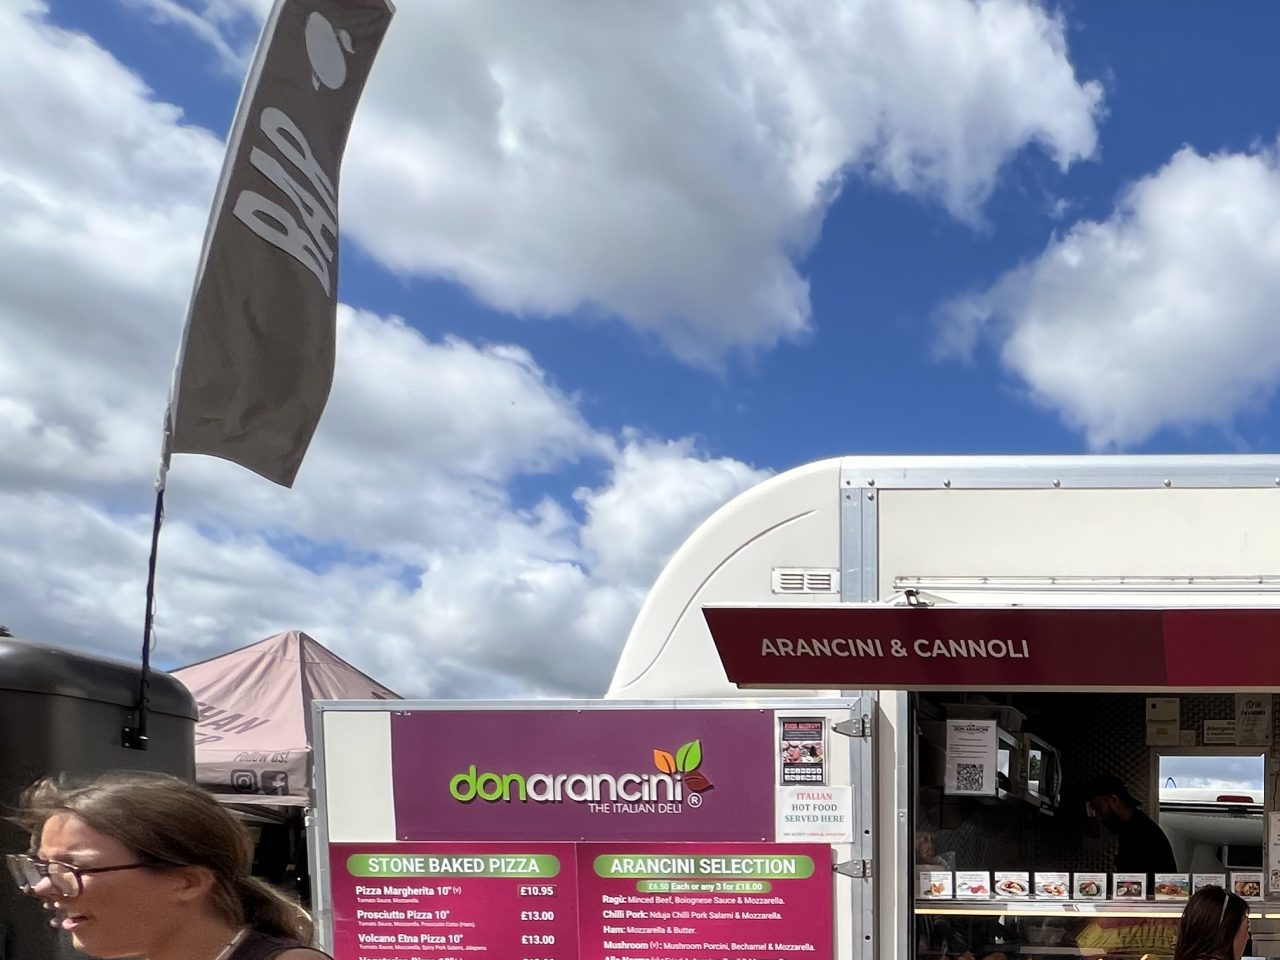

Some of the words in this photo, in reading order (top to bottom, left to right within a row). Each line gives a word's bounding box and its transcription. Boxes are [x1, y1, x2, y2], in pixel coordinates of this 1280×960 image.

[761, 638, 884, 657] ARANCINI
[890, 639, 908, 657] &
[914, 639, 1030, 658] CANNOLI
[449, 764, 683, 802] donarancini
[796, 792, 833, 801] ITALIAN
[588, 803, 611, 814] THE
[612, 803, 656, 814] ITALIAN
[658, 803, 682, 814] DELI
[791, 803, 811, 812] HOT
[813, 803, 838, 812] FOOD
[784, 815, 819, 823] SERVED
[820, 815, 845, 823] HERE
[368, 858, 426, 873] STONE
[428, 858, 485, 873] BAKED
[489, 858, 540, 873] PIZZA
[610, 858, 695, 874] ARANCINI
[699, 858, 796, 874] SELECTION
[355, 886, 382, 896] Pizza
[383, 886, 435, 897] Margherita
[520, 886, 554, 896] £10.95
[670, 882, 690, 890] Each
[700, 884, 715, 892] any
[627, 896, 655, 904] Minced
[655, 896, 674, 905] Beef,
[674, 896, 712, 906] Bolognese
[713, 896, 736, 904] Sauce
[356, 910, 405, 920] Prosciutto
[406, 910, 433, 920] Pizza
[521, 911, 555, 921] £13.00
[603, 910, 625, 919] Chilli
[649, 911, 671, 920] Nduja
[672, 911, 690, 919] Chilli
[691, 911, 708, 919] Pork
[627, 926, 666, 934] Mozzarella
[357, 933, 396, 944] Volcano
[397, 933, 419, 943] Etna
[420, 934, 446, 944] Pizza
[521, 935, 555, 945] £13.00
[603, 941, 649, 950] Mushroom
[663, 942, 702, 950] Mushroom
[703, 942, 730, 951] Porcini,
